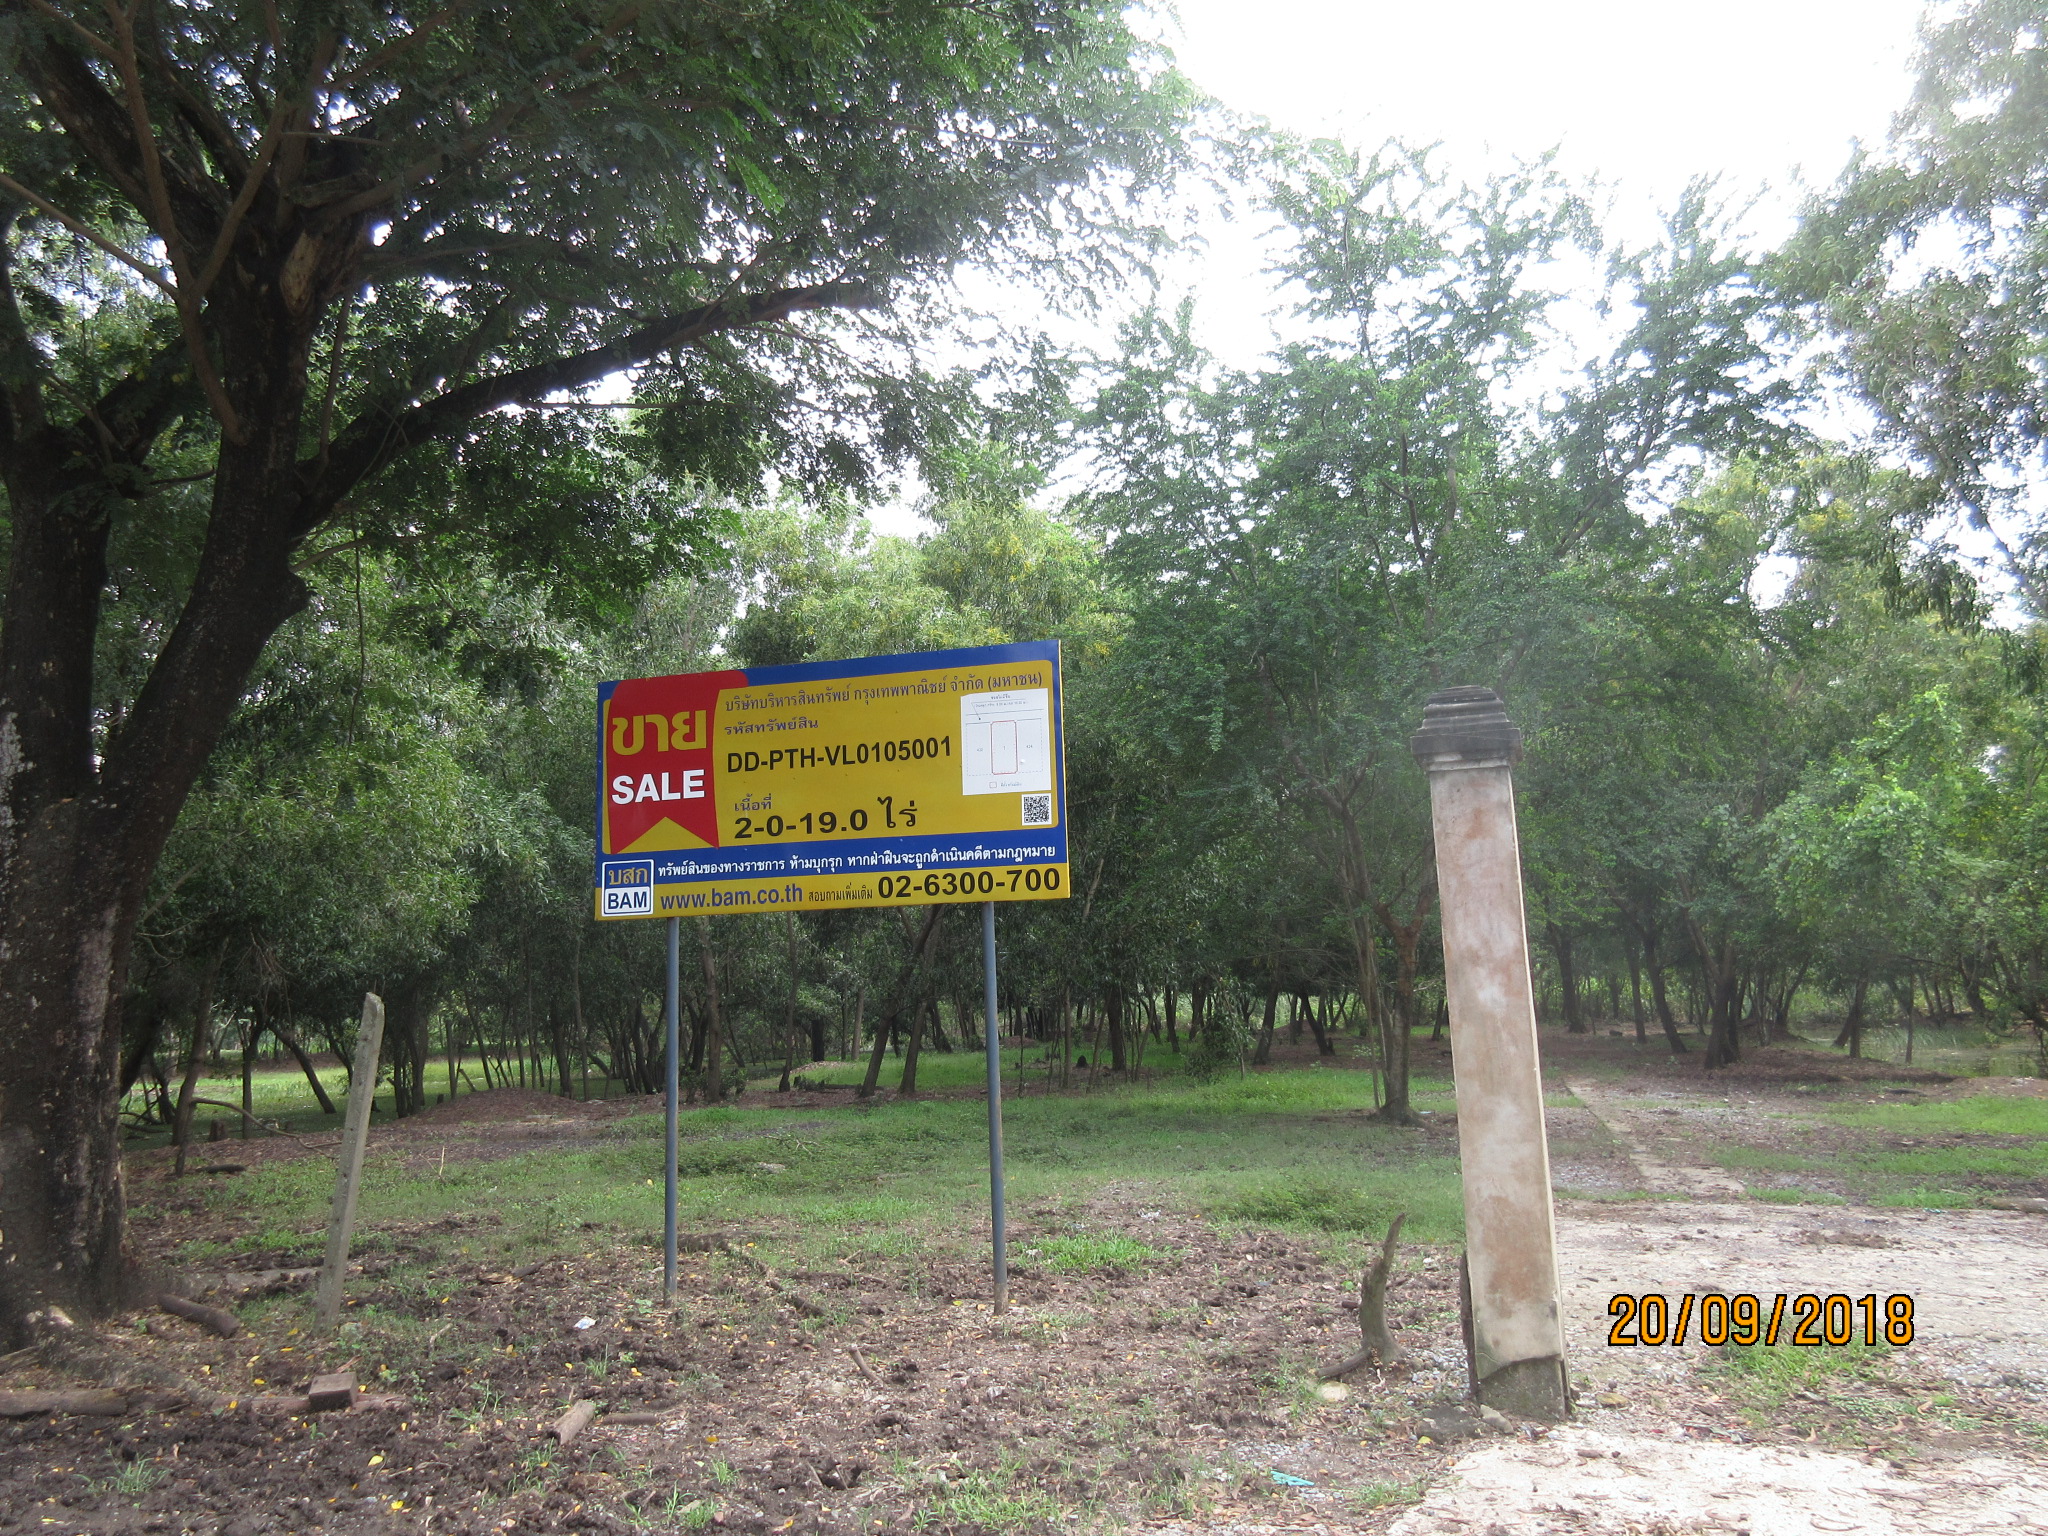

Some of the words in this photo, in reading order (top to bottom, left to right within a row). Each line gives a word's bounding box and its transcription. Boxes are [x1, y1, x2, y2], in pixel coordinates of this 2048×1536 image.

[725, 684, 851, 711] บริษัทบริหารสินทรัพย์
[853, 676, 946, 705] กรุงเทพพาณิชย์
[950, 673, 983, 692] จำกัด
[986, 671, 1043, 692] (มหาชน)
[612, 710, 707, 756] ขาย
[724, 716, 819, 736] รหัสทรัพย์สิน
[727, 735, 952, 773] DD-PTH-VL0105001
[611, 769, 705, 805] SALE
[734, 794, 772, 812] เนื้อที่
[734, 808, 868, 839] 2-0-19.0
[878, 797, 918, 829] ไร่
[608, 866, 648, 886] บสก
[658, 857, 786, 876] ทรัพย์สินของทางราชการ
[789, 853, 843, 873] ห้ามบุกรุก
[847, 845, 1056, 869] หากฝ่าฝืนจะถูกดำเนินคดีตามกฎหมาย
[607, 891, 648, 910] BAM
[660, 885, 803, 910] www.bam.co.th
[808, 882, 873, 902] สอบถามเพิ่มเติม
[878, 868, 1061, 898] 02-6300-700
